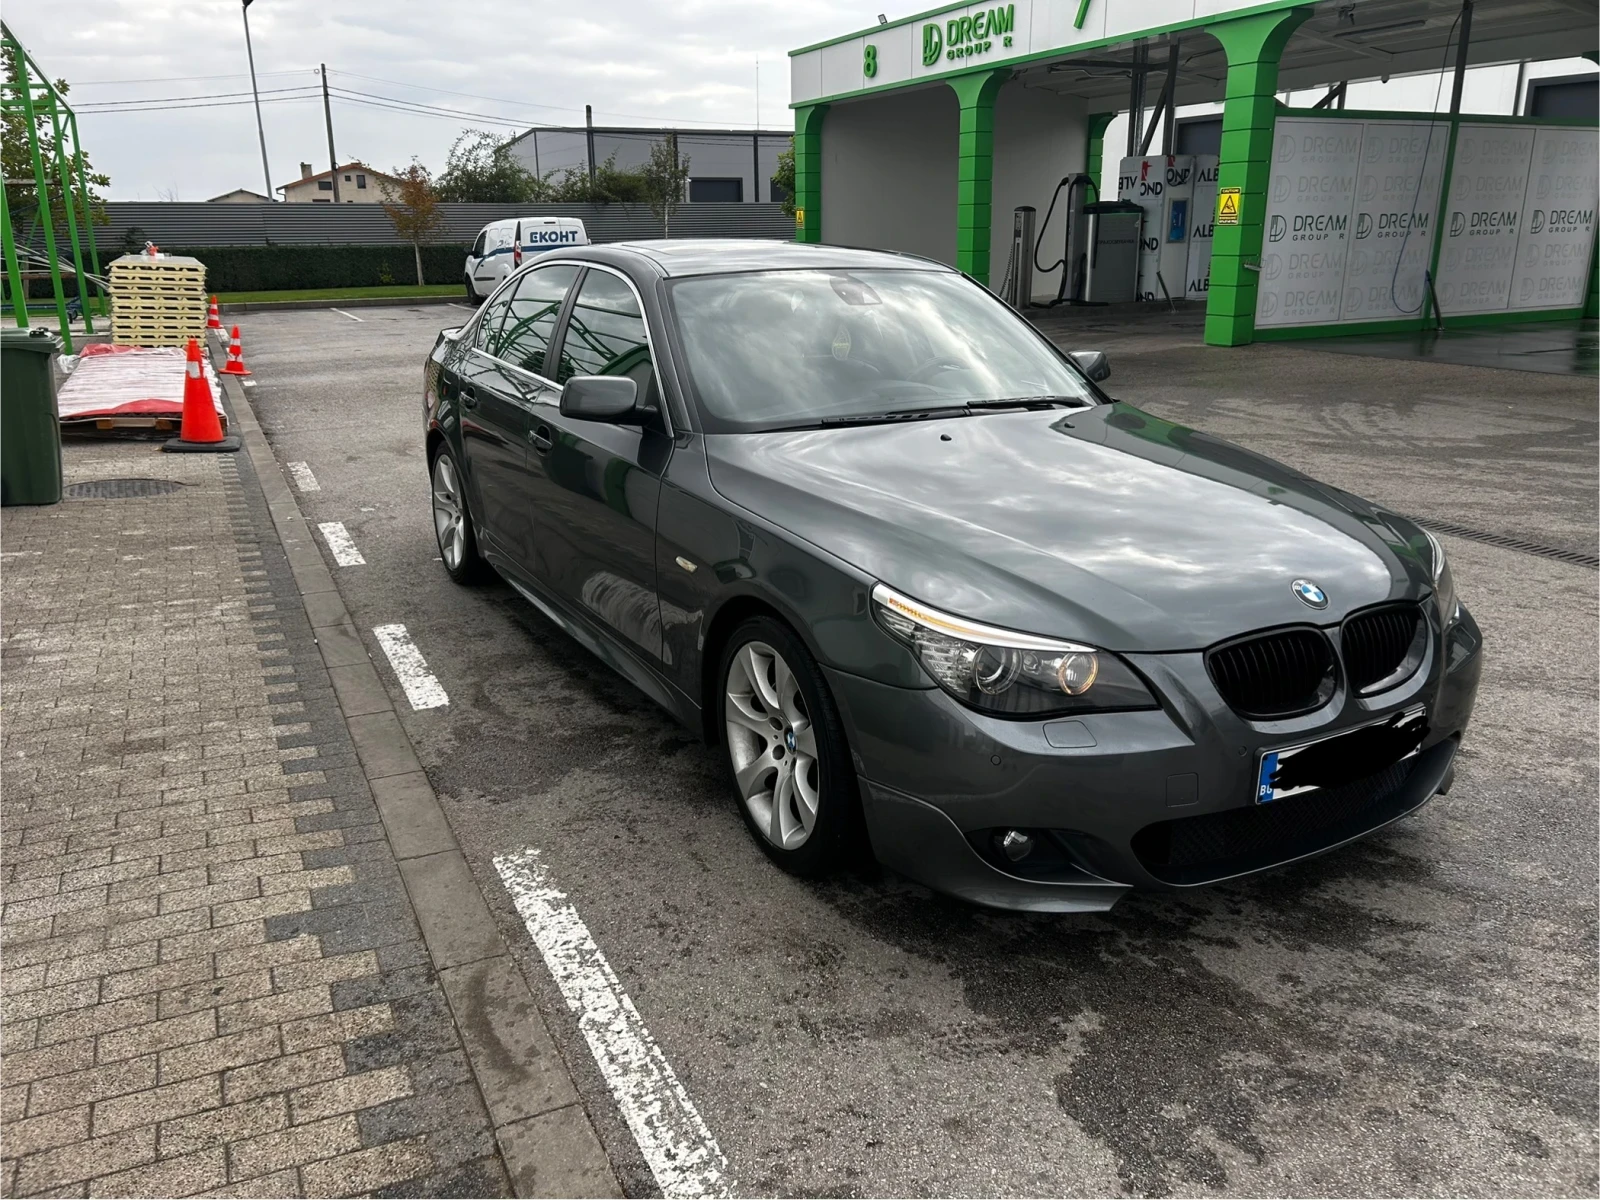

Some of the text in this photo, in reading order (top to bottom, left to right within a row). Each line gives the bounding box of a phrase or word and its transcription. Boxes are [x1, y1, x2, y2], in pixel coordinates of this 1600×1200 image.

[946, 4, 1014, 46] DREAM
[946, 36, 1012, 60] GROUP R
[863, 45, 877, 78] 8
[1302, 136, 1358, 153] DREAM
[1389, 138, 1440, 153] DREAM
[1298, 176, 1353, 192] DREAM
[1384, 176, 1434, 192] DREAM
[1476, 177, 1522, 191] DREAM
[1293, 215, 1347, 231] DREAM
[1379, 213, 1429, 229] DREAM
[1471, 211, 1517, 226] DREAM
[1550, 210, 1593, 224] DREAM
[529, 231, 578, 243] ЕКОНТ
[1544, 244, 1587, 258] DREAM
[1289, 254, 1342, 270] DREAM
[1460, 280, 1506, 296] DREAM
[1539, 277, 1581, 291] DREAM
[1284, 291, 1338, 307] DREAM
[1368, 287, 1418, 302] DREAM
[1283, 308, 1320, 316] GROUP
